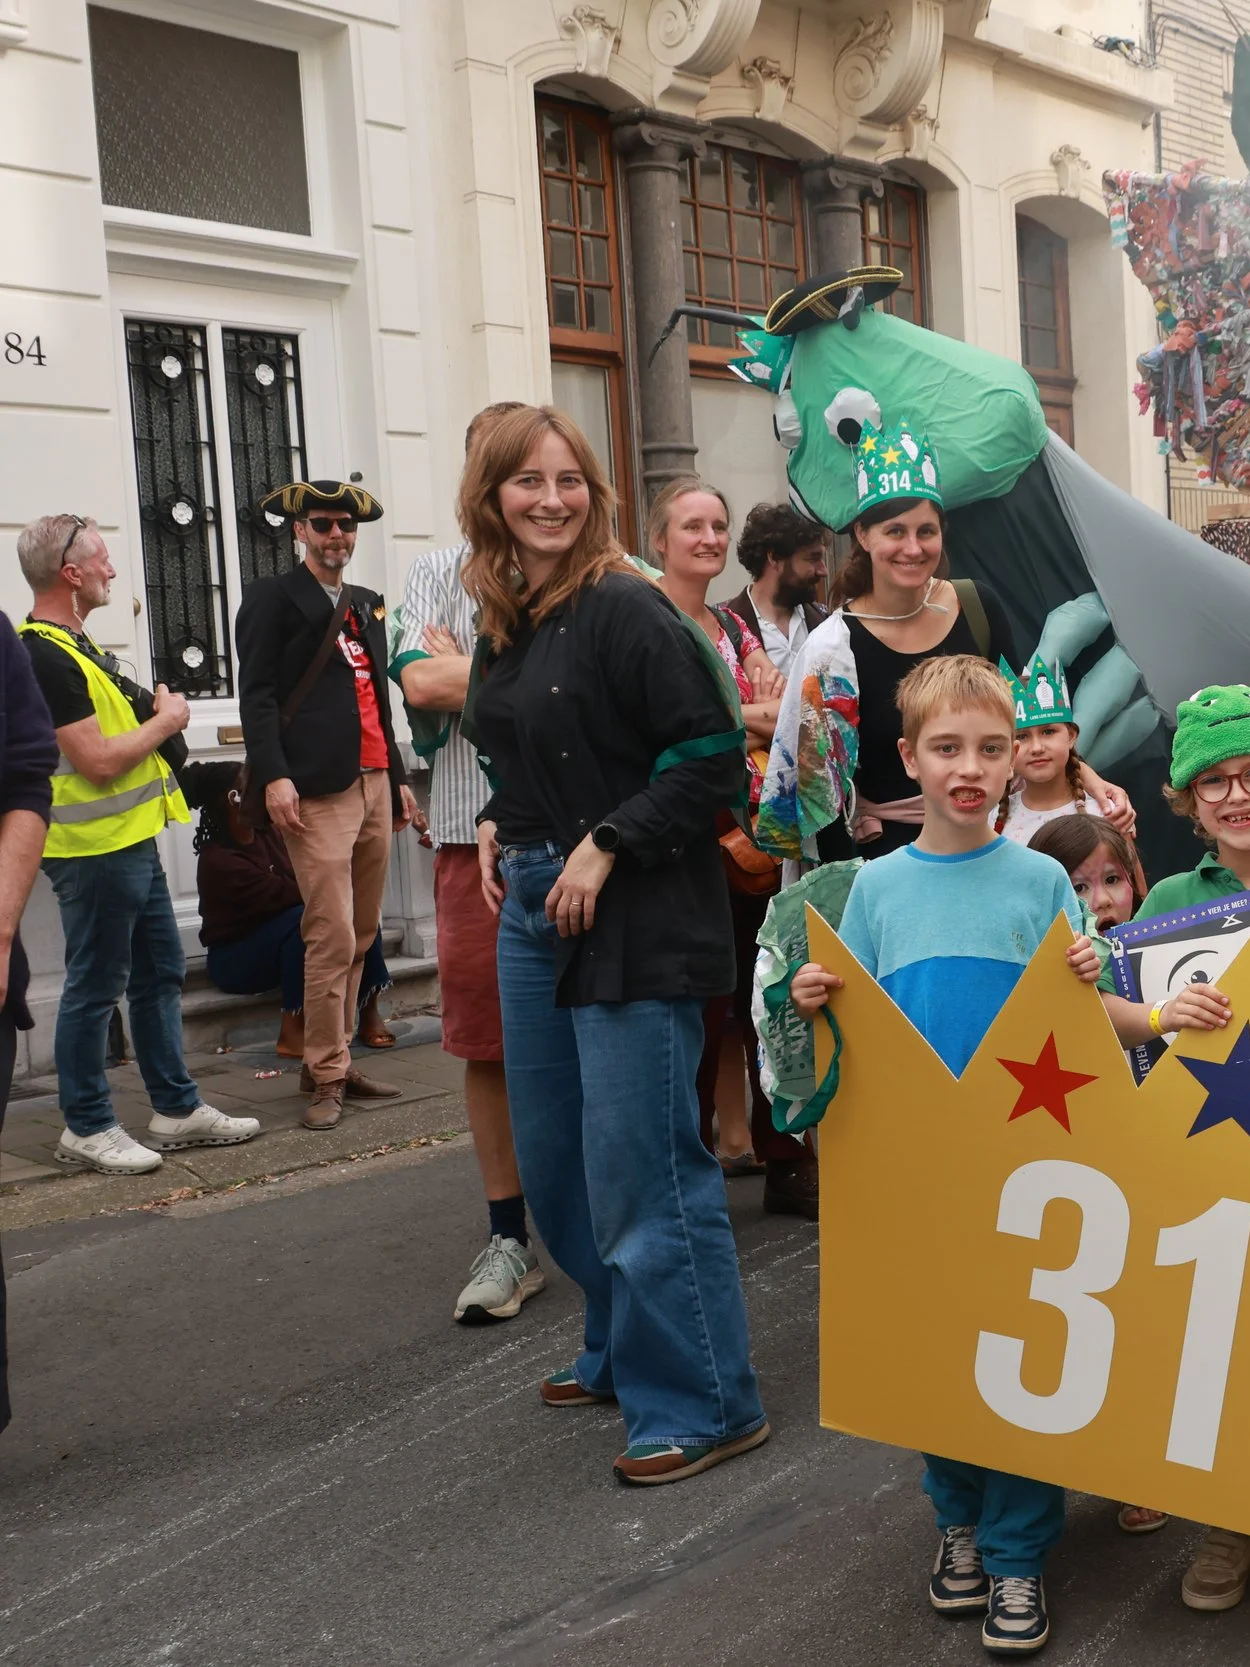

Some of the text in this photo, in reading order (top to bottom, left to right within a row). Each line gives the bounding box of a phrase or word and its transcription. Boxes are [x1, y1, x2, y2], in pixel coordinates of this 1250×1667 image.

[4, 331, 47, 367] 84
[878, 470, 911, 495] 314
[1015, 700, 1027, 722] 4
[1207, 898, 1248, 916] VIER JE MEE?
[1117, 958, 1129, 991] REUS
